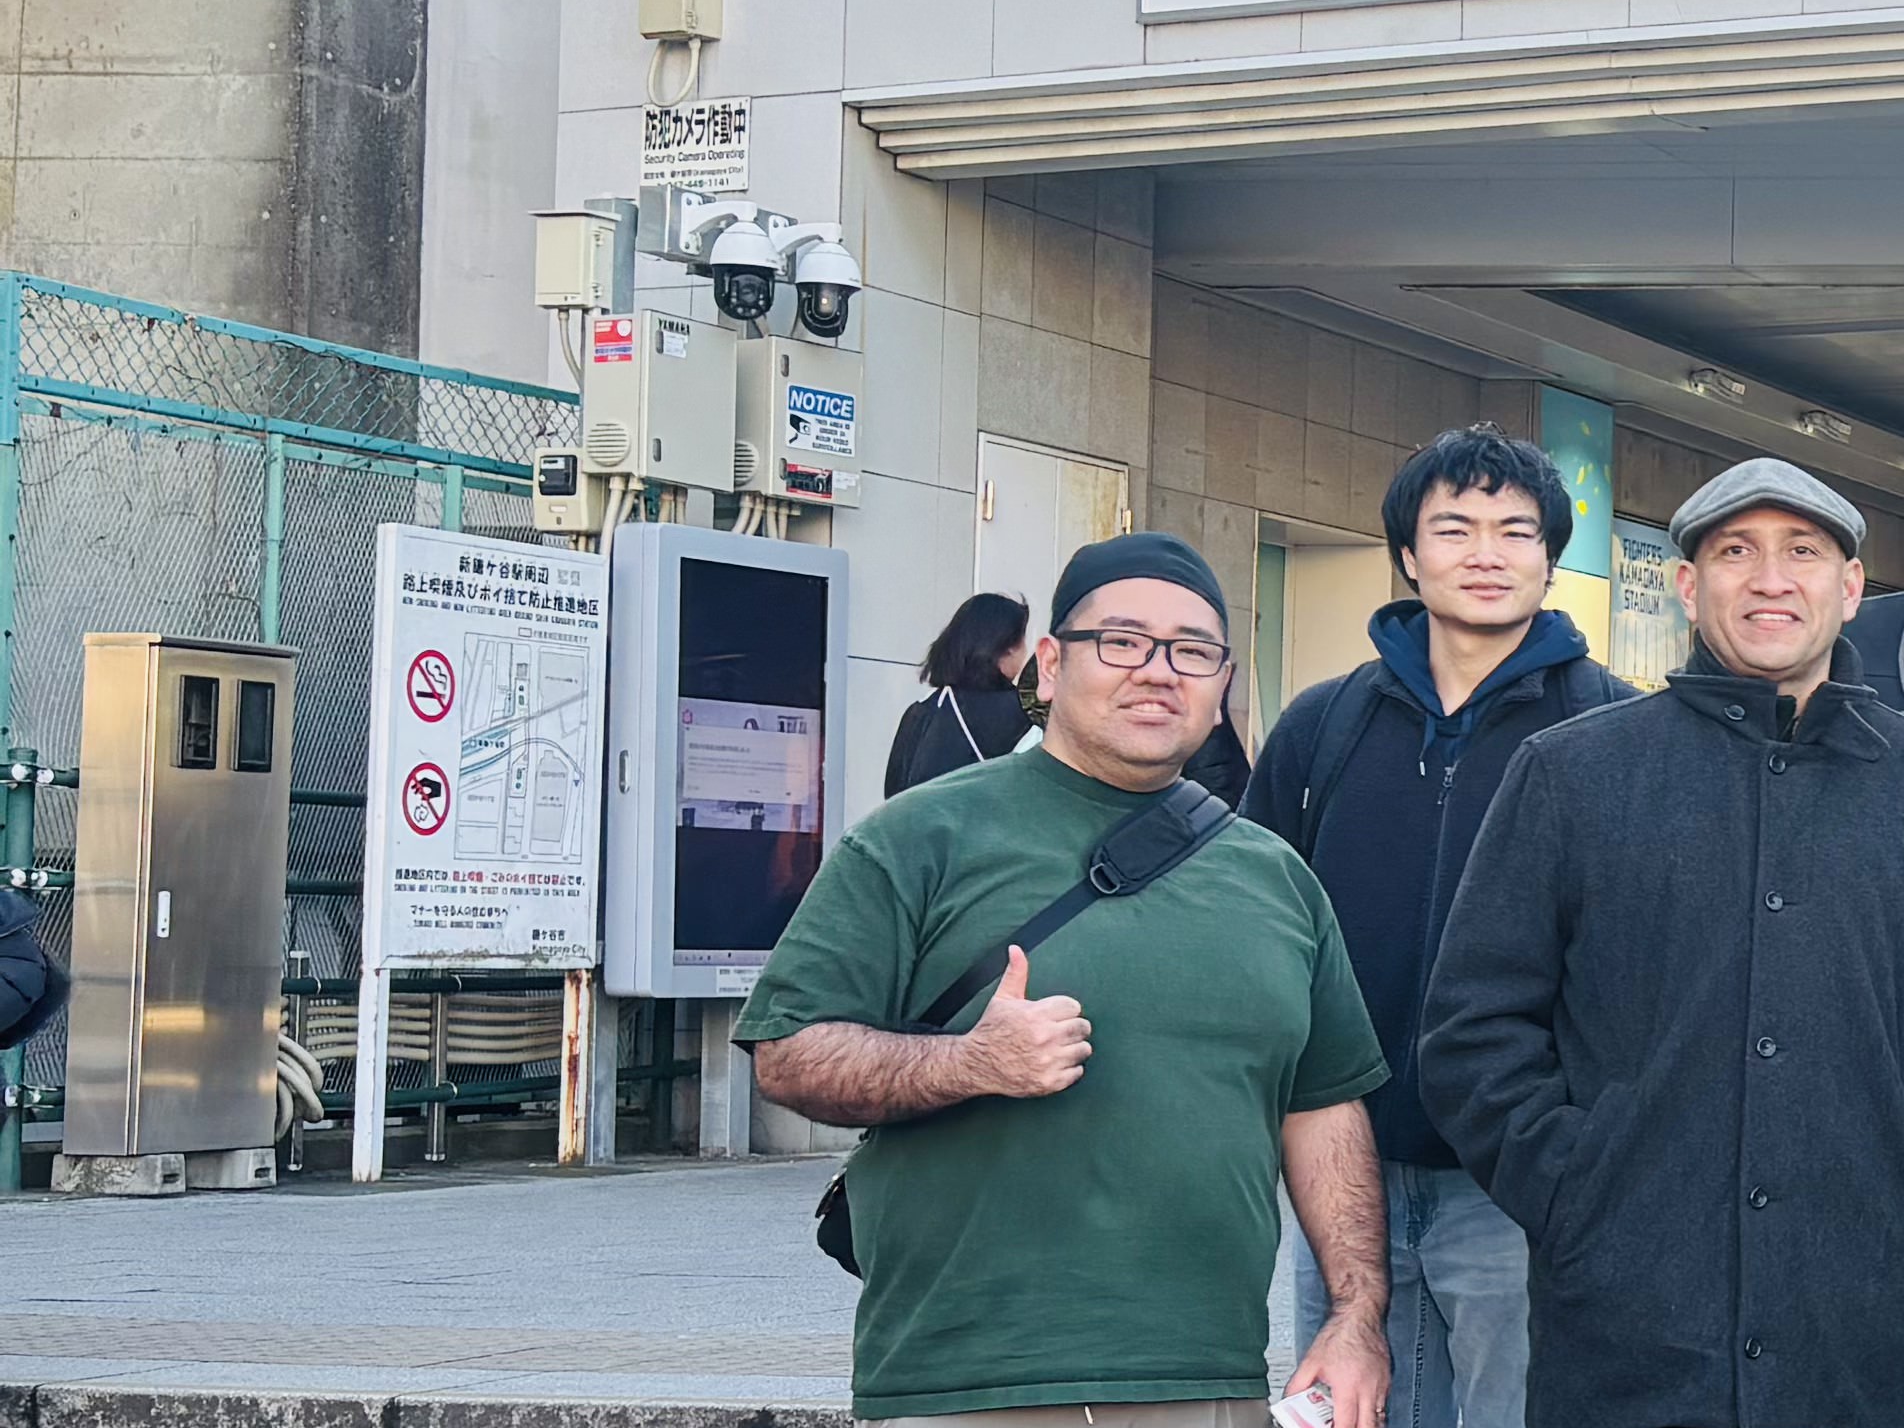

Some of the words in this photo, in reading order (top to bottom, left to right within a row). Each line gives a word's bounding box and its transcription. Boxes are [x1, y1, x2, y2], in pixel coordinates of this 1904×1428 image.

[644, 154, 675, 164] Security
[678, 151, 706, 162] Camera
[789, 389, 854, 419] NOTICE
[1623, 538, 1663, 566] FIGHTERS
[1624, 589, 1660, 616] STADIUM
